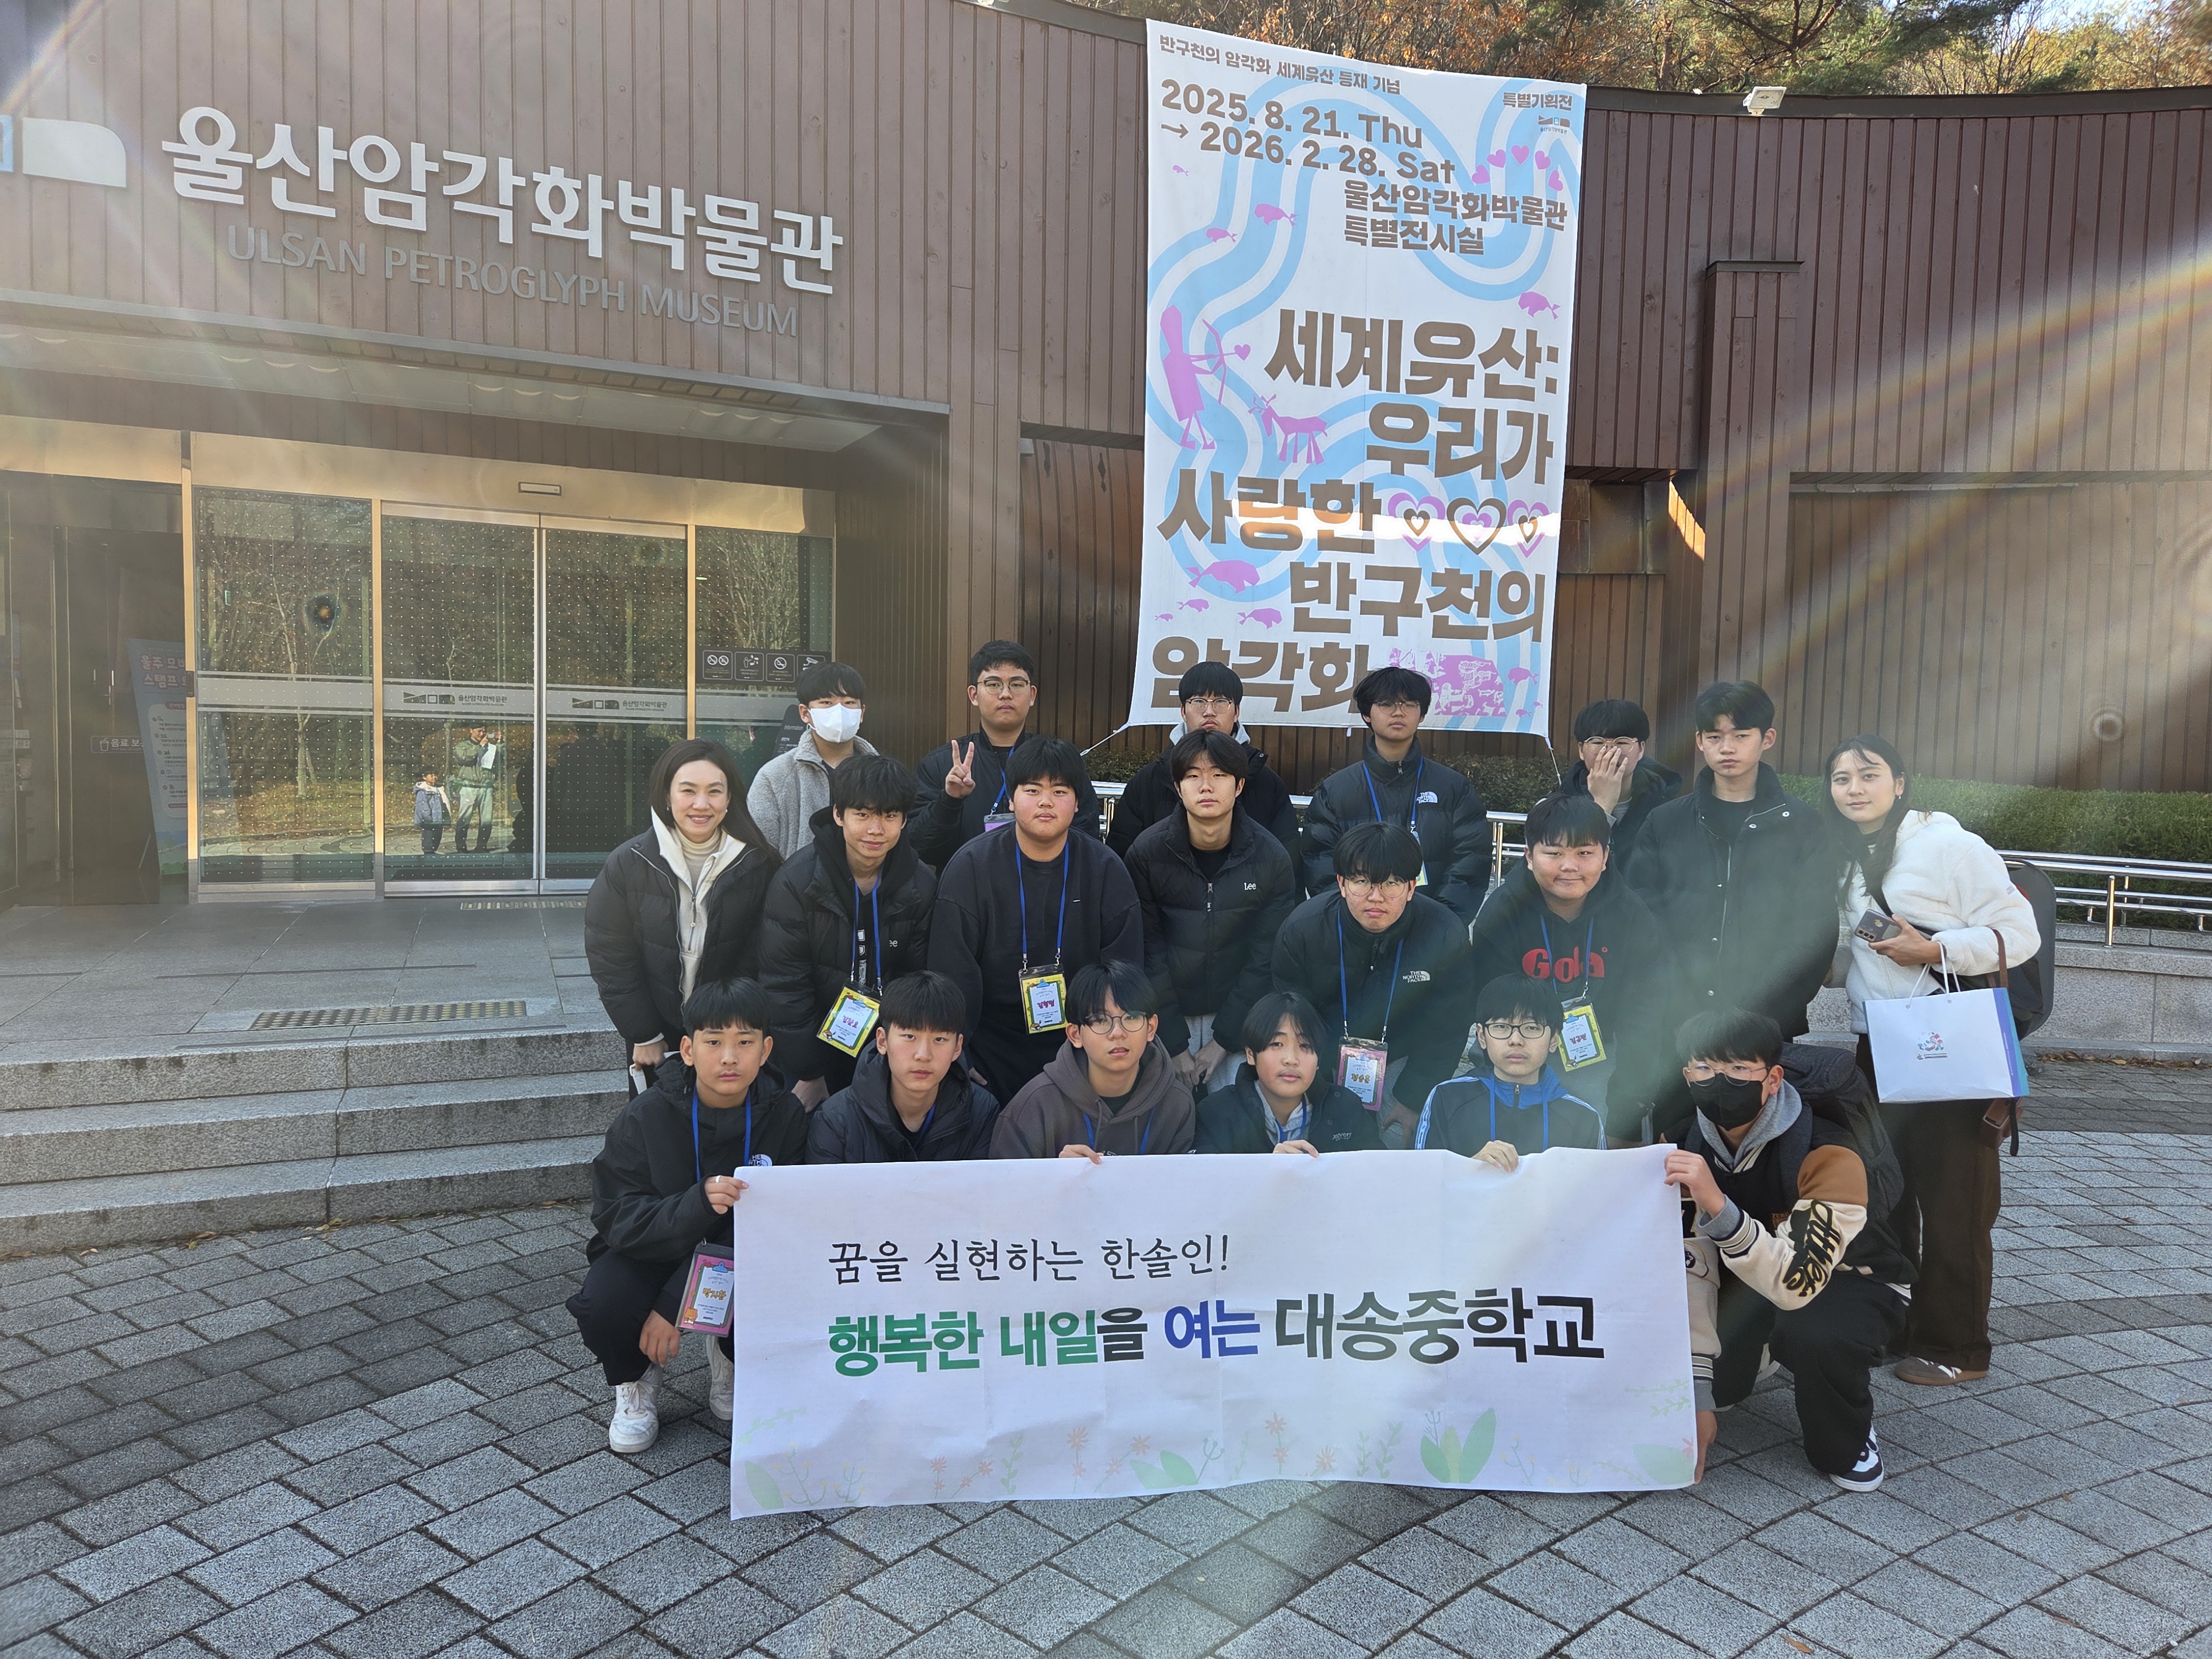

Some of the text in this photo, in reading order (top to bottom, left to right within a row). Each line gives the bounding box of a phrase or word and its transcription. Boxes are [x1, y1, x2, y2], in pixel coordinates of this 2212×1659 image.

[1160, 35, 1400, 95] 반구천의 암각화 세계유산 등재 기념
[1161, 79, 1422, 149] 2025. 8. 21. Thu
[1503, 92, 1572, 111] 특별기획전
[1201, 122, 1455, 184] 2026. 2. 28. Sat
[162, 107, 843, 295] 울산암각화박물관
[1344, 180, 1568, 231] 울산암각화박물관
[1344, 215, 1484, 255] 특별전시실
[228, 225, 797, 337] ULSAN PETROGLYPH MUSEUM
[1265, 309, 1559, 402] 세계유산:
[1366, 402, 1554, 484] 우리가
[1157, 468, 1382, 554] 사랑한
[1290, 562, 1546, 643] 반구천의
[1244, 882, 1257, 890] Lee
[1522, 946, 1605, 983] Gola
[828, 1234, 1229, 1285] 꿈을 실현하는 한솔인!
[828, 1287, 1605, 1377] 행복한 내일을 여는 대송중학교
